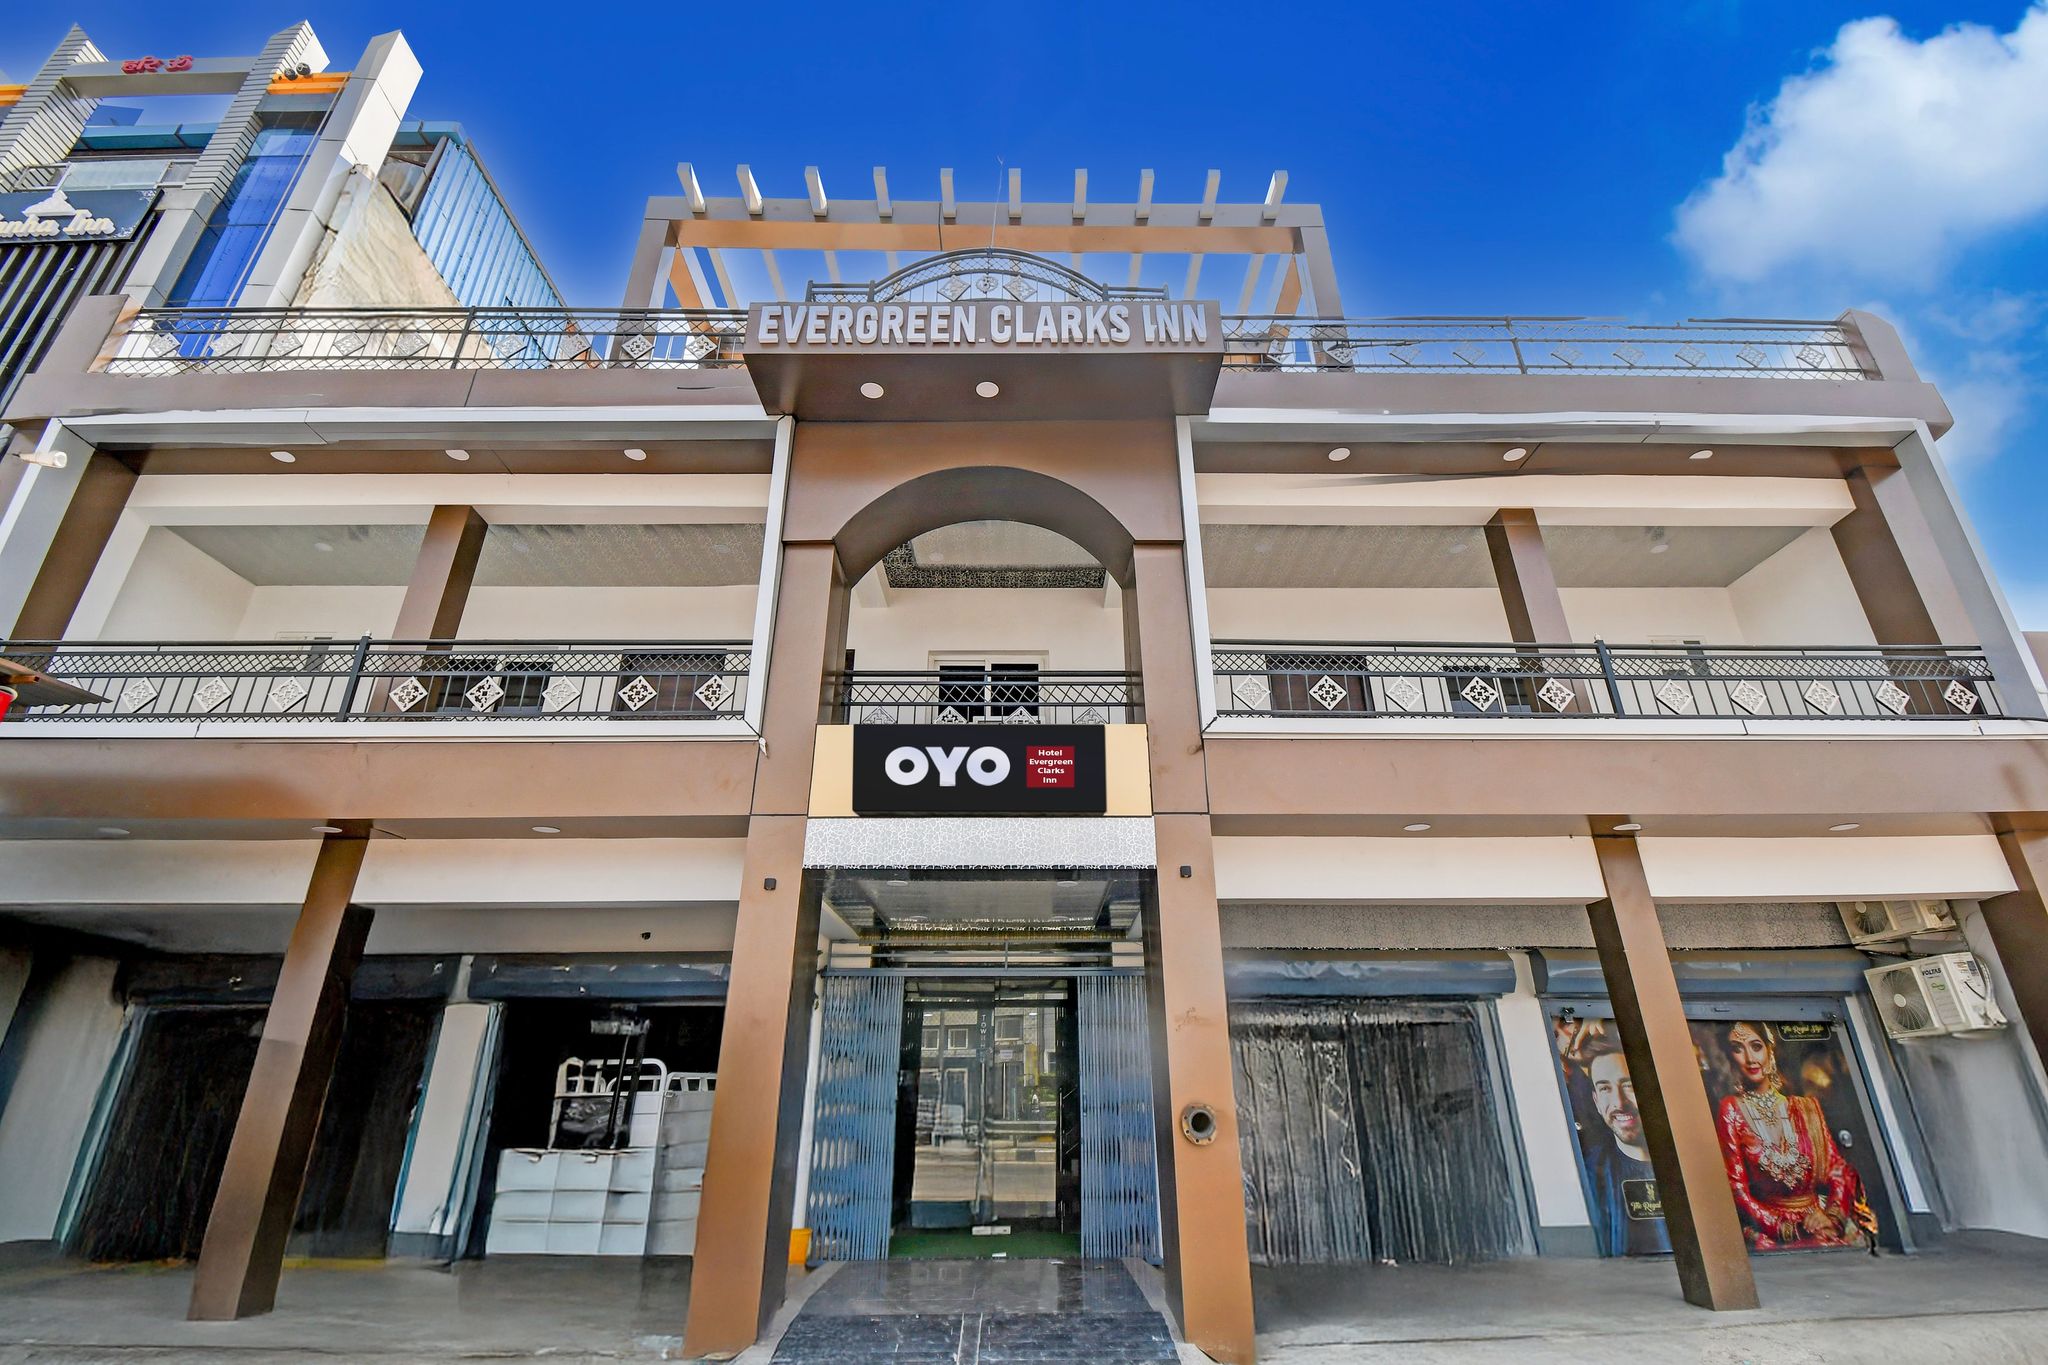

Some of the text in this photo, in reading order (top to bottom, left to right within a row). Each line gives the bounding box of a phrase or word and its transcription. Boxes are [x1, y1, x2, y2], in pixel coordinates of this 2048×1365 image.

[63, 209, 116, 236] Inn
[990, 304, 1131, 344] CLARKS
[1142, 303, 1208, 343] INN
[1038, 749, 1063, 757] Hotel
[885, 746, 1010, 787] OYO
[1029, 758, 1073, 767] Evergreen
[1042, 776, 1057, 784] Inn
